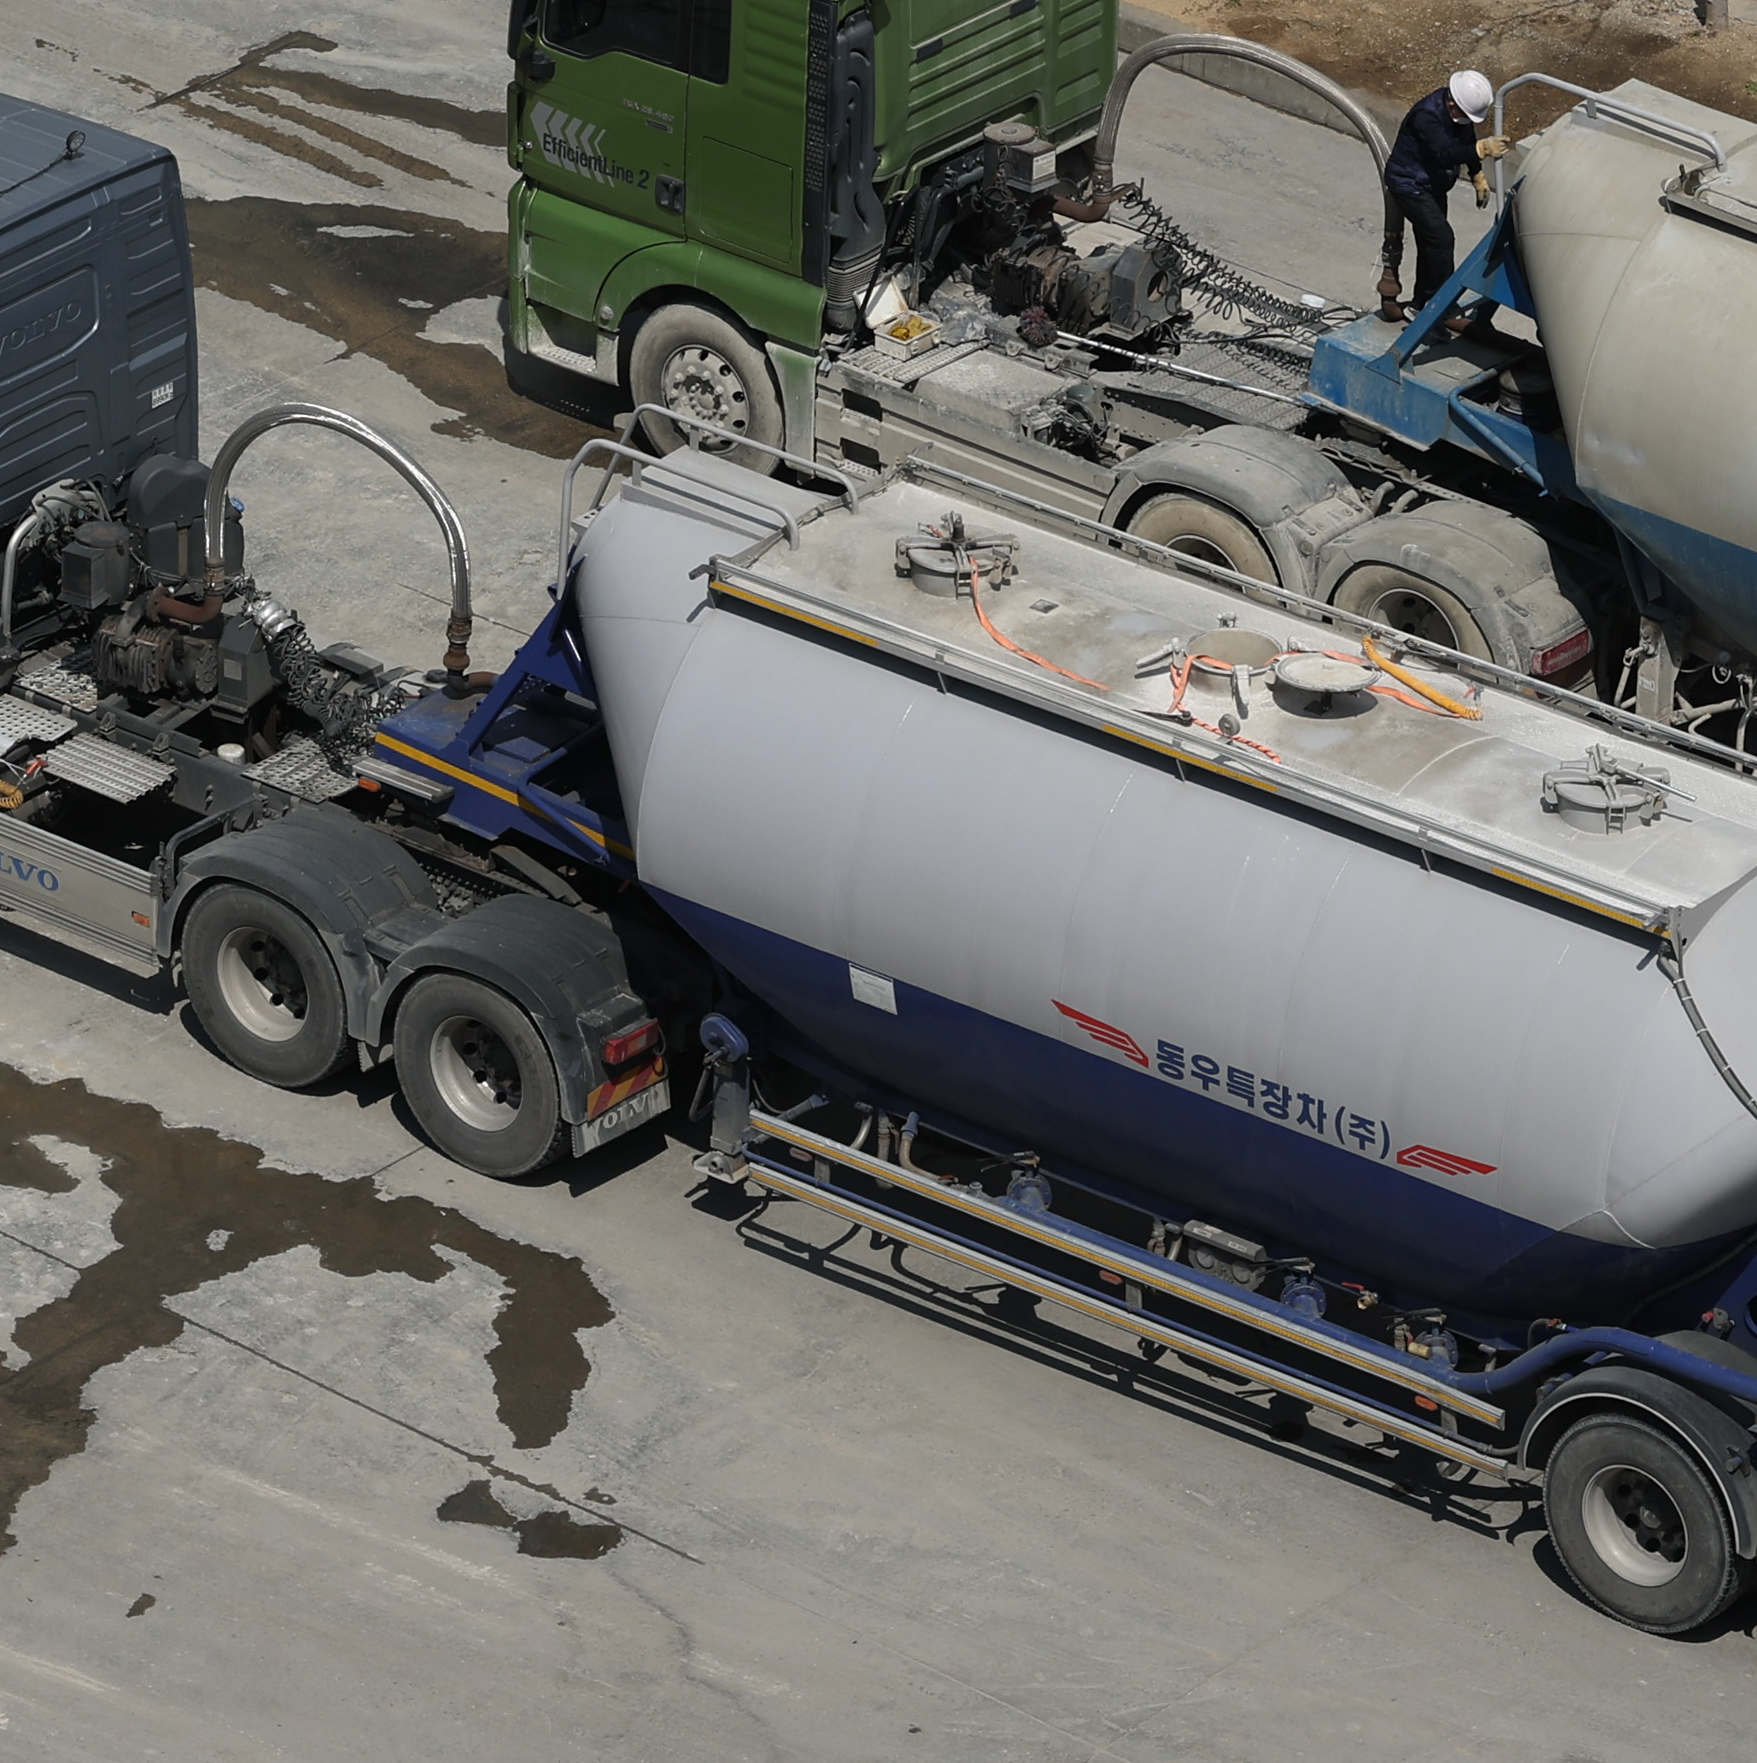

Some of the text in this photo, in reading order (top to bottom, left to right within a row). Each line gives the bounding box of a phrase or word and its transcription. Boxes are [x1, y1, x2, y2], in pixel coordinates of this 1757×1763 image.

[543, 133, 650, 189] EfficientLine 2
[1156, 1039, 1390, 1159] 동우특장차(주)
